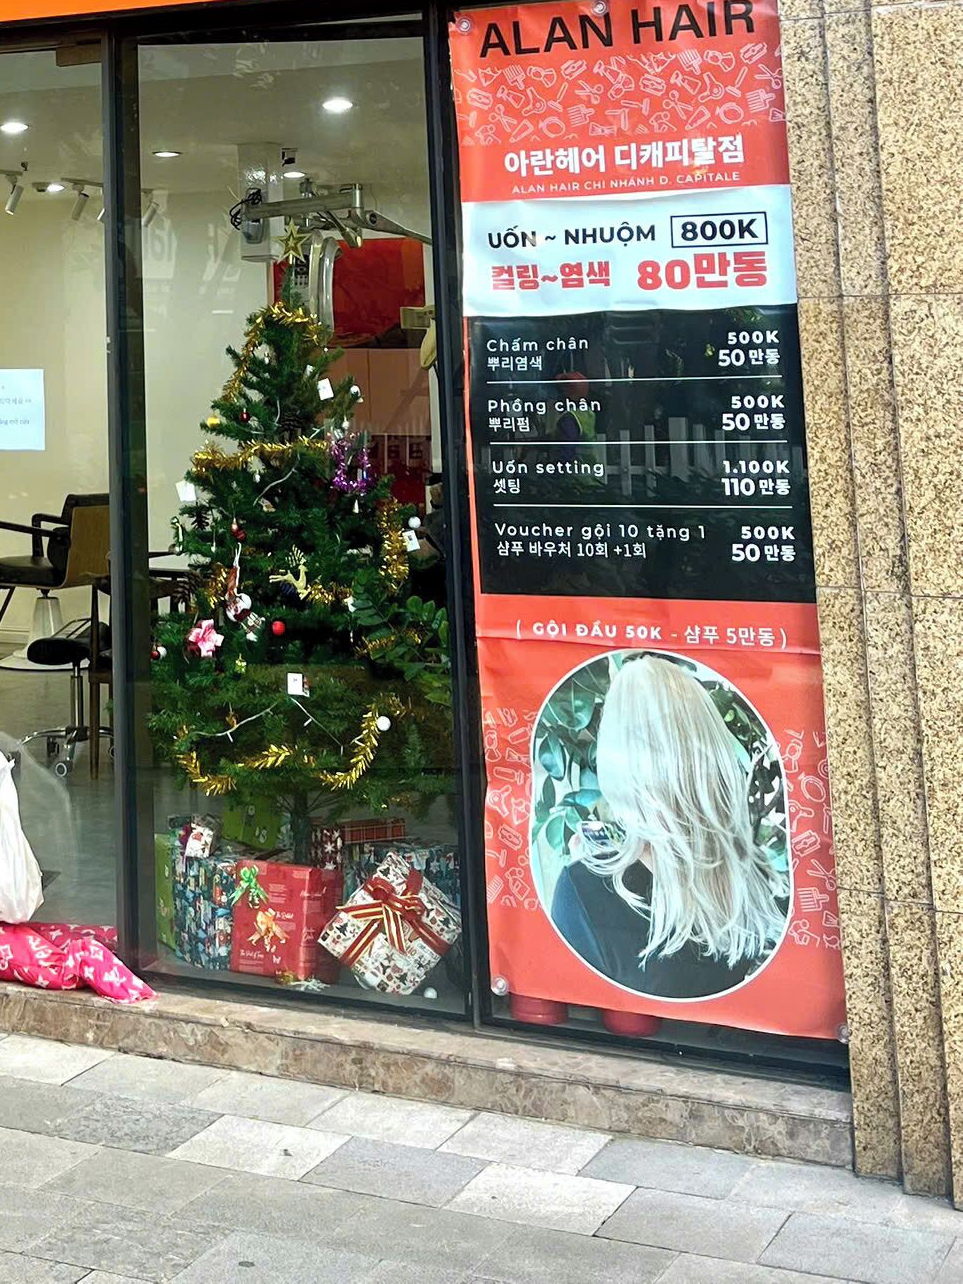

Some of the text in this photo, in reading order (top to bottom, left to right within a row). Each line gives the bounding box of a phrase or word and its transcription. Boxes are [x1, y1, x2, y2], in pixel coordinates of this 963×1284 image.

[479, 13, 614, 58] ALAN
[504, 134, 745, 177] 아란헤어 디캐피탈점
[512, 171, 740, 195] ALAN HAIR CHI NHÁNH D. CAPITALE
[488, 225, 536, 248] UỐN
[564, 222, 656, 247] NHUỘM
[680, 219, 758, 242] 800K
[491, 260, 611, 292] 컬링~염색
[486, 330, 780, 352] Chấm chân 500K
[487, 355, 542, 372] 뿌리염색
[554, 398, 601, 412] chân
[731, 395, 785, 409] 500K
[488, 416, 530, 432] 뿌리펌
[492, 460, 790, 477] Uốn setting 1.100K
[493, 478, 520, 494] 셋팅
[494, 523, 795, 541] Voucher gội 10 tặng 1 500K
[497, 541, 524, 556] 샴푸
[529, 541, 571, 556] 바우처
[577, 543, 608, 558] 10회
[533, 620, 567, 638] GỘI
[625, 625, 662, 639] 50K
[684, 625, 719, 644] 샴푸
